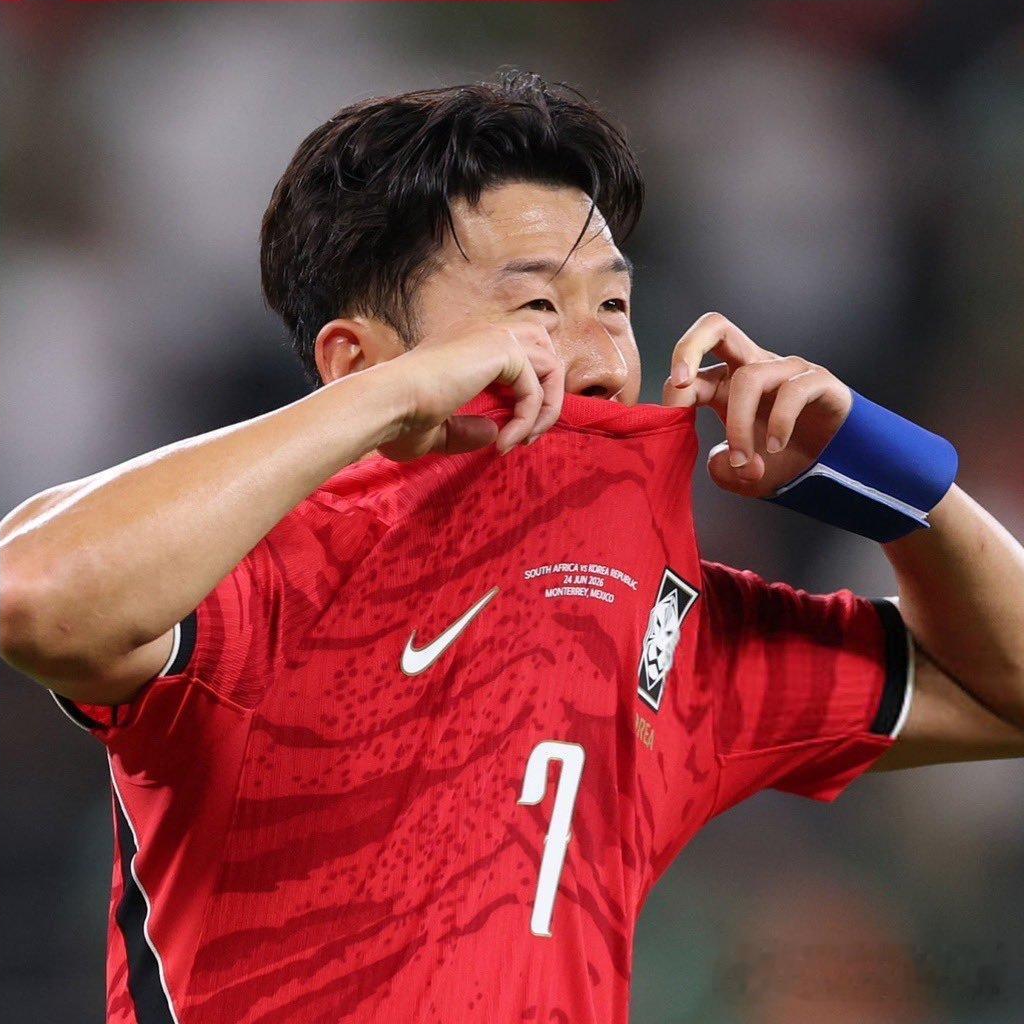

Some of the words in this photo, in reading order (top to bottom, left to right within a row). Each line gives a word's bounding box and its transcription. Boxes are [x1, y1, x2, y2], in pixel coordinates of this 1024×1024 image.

[524, 564, 552, 580] SOUTH
[552, 562, 579, 573] AFRICA
[588, 563, 610, 576] KOREA
[609, 569, 639, 591] REPUBLIC
[563, 574, 573, 584] 24
[573, 575, 588, 585] JUN
[588, 575, 604, 587] 2026
[545, 586, 589, 599] MONTERREY,
[590, 588, 615, 604] MEXICO
[516, 739, 586, 937] 7
